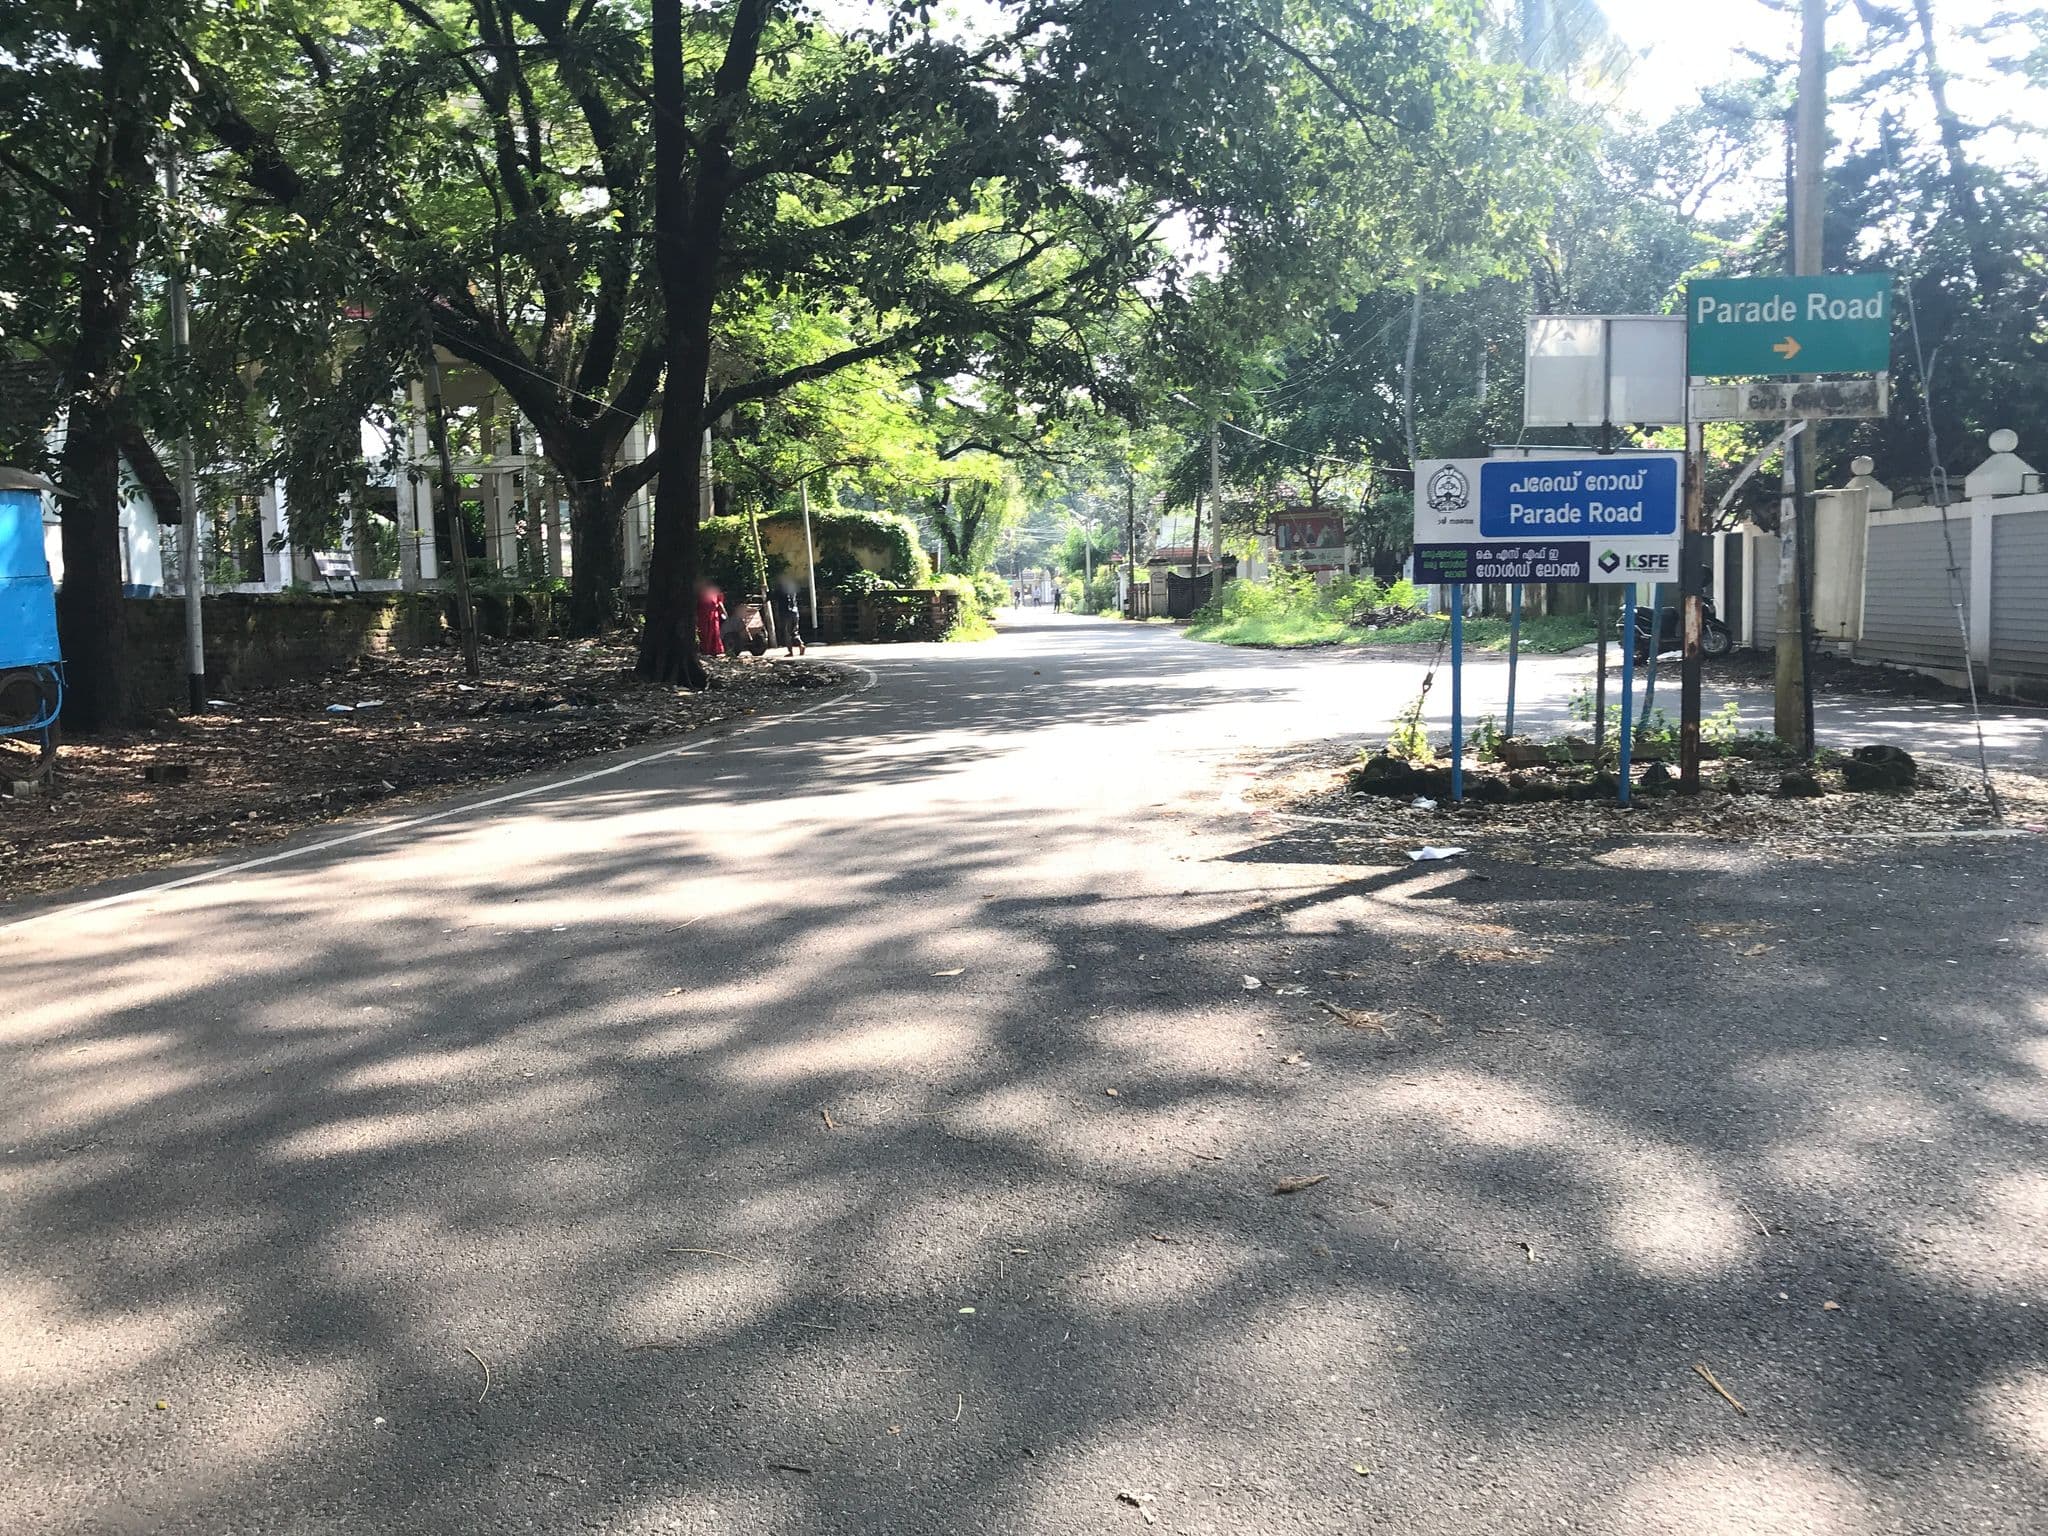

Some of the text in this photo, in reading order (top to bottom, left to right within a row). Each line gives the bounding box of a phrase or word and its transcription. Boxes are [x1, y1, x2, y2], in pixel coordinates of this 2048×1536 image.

[1698, 291, 1884, 324] Parade Road
[1509, 469, 1648, 493] പരേഡ് റോഡ്
[1510, 502, 1643, 524] Parade Road
[1625, 554, 1669, 569] KSFE
